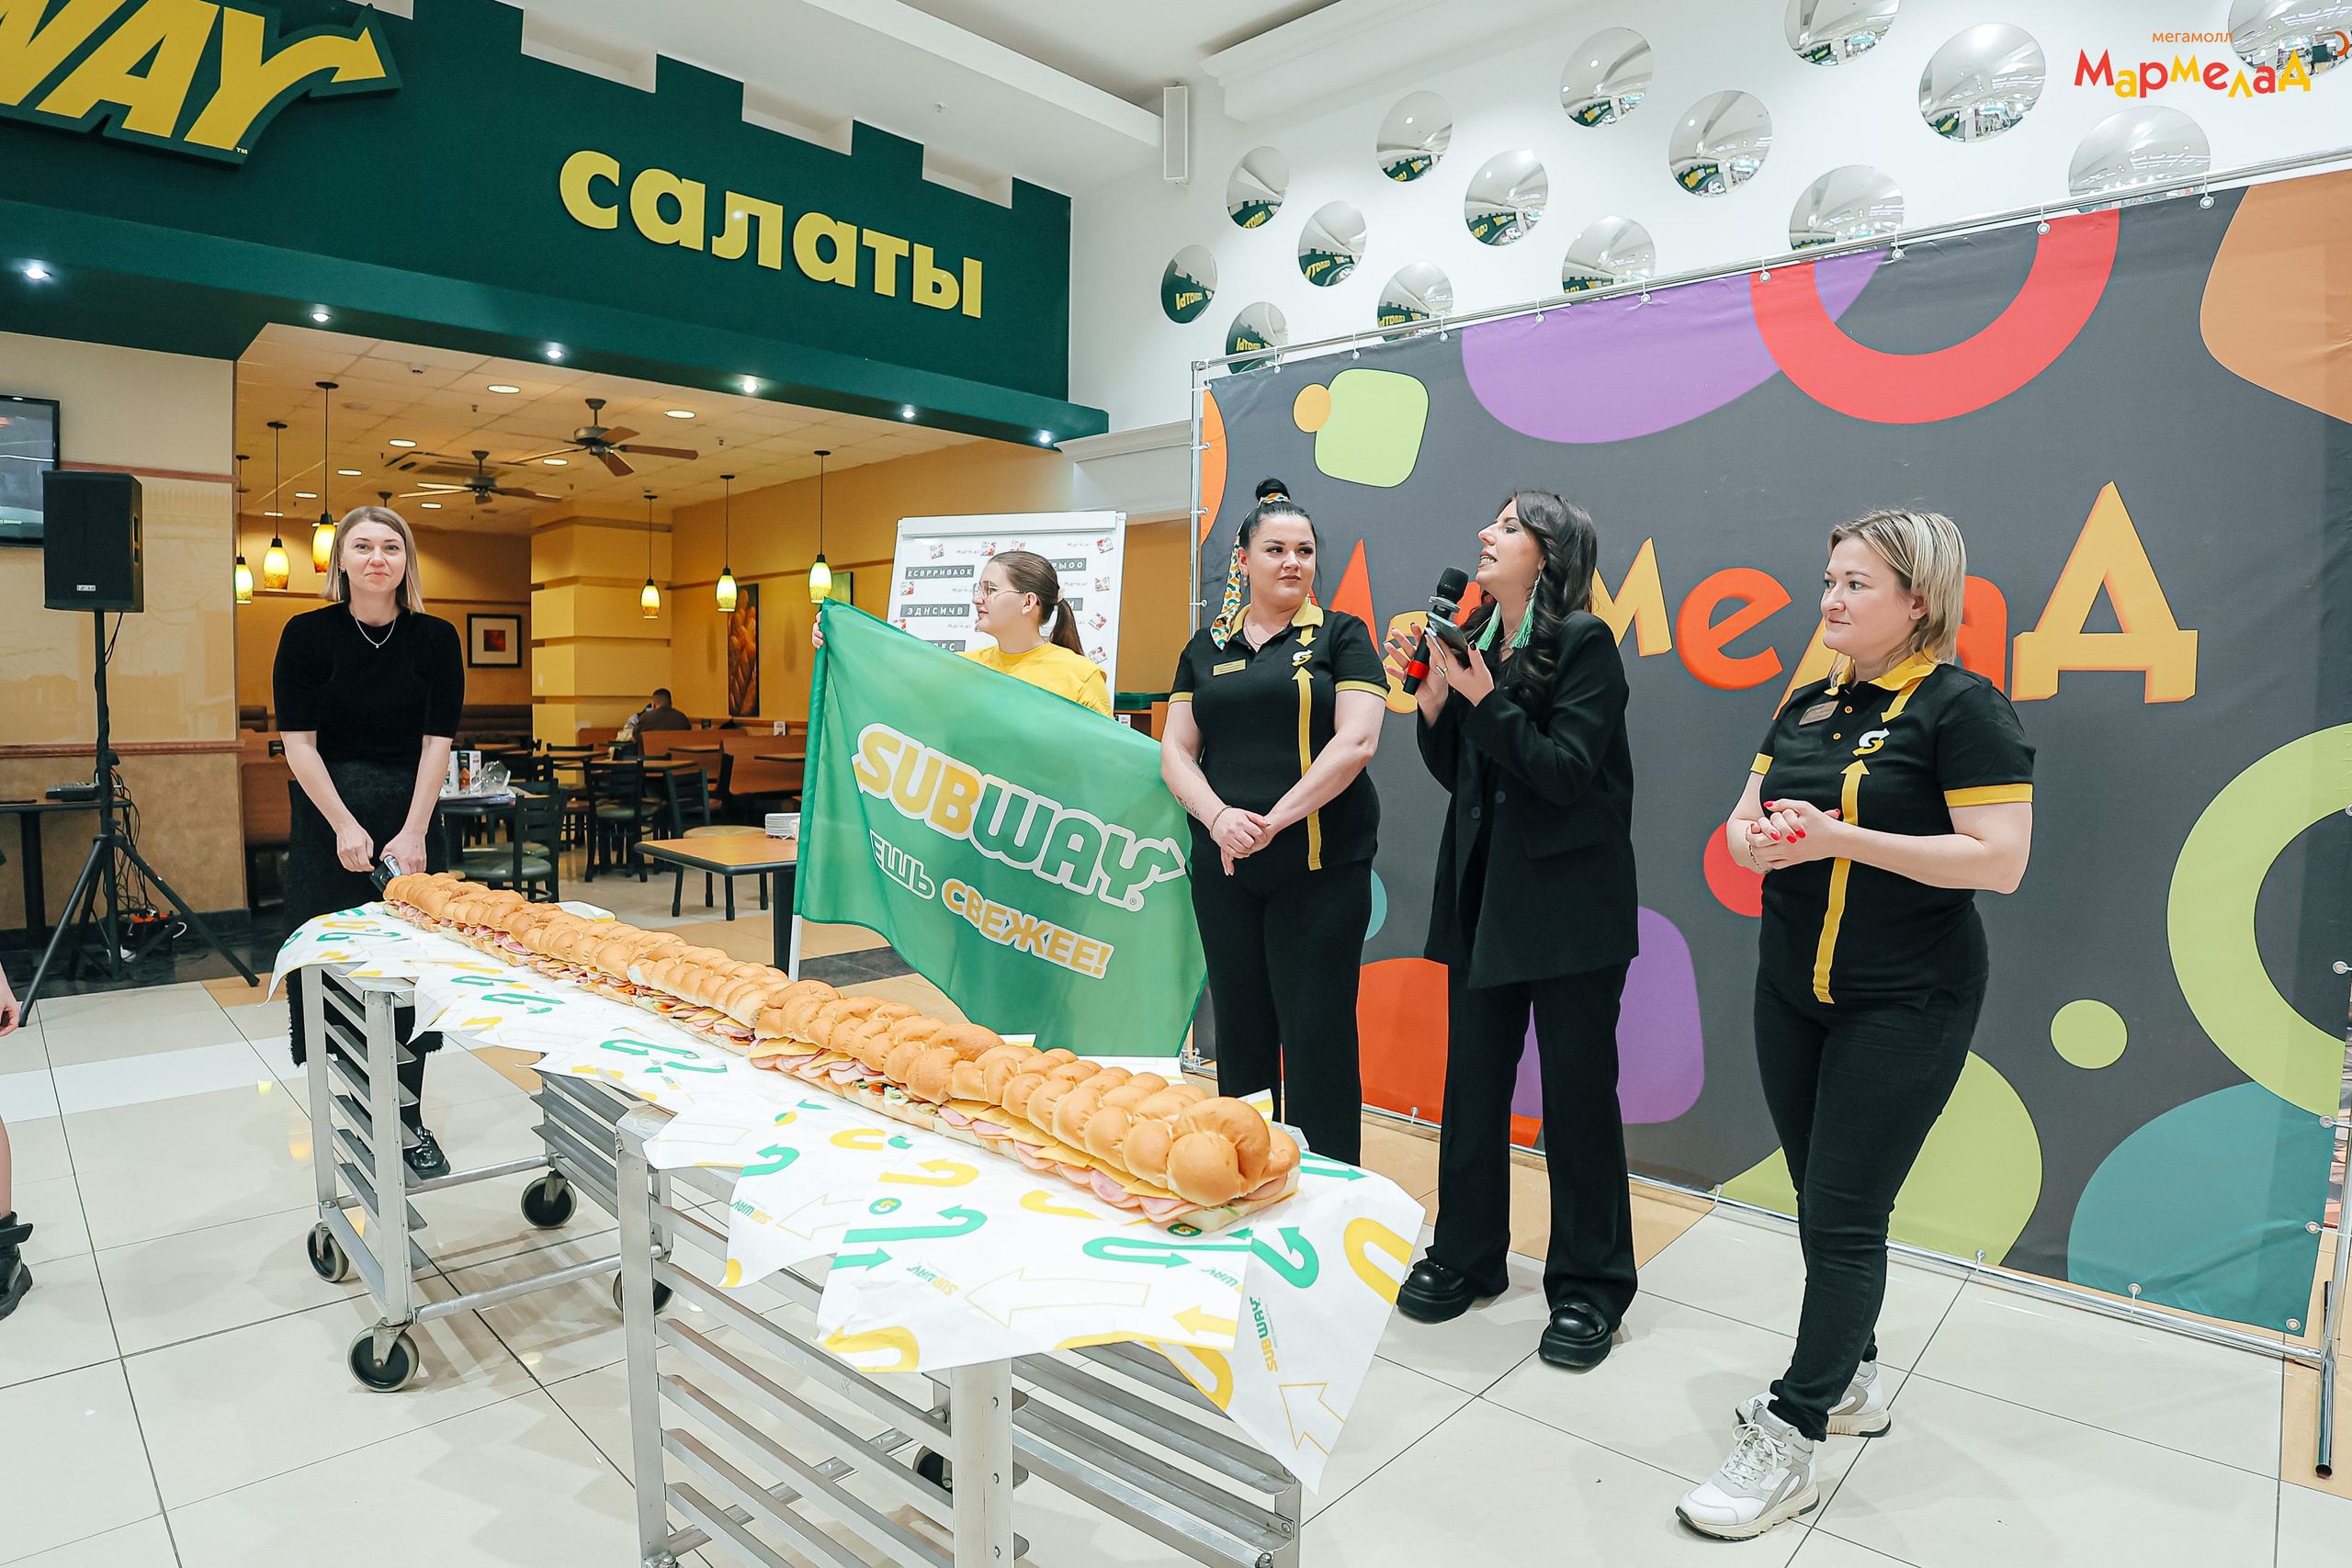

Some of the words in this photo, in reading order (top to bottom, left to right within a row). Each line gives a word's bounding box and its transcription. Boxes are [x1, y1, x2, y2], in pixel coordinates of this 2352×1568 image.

[560, 150, 982, 319] салаты
[906, 606, 964, 616] ЭДНСИЧВ
[908, 569, 973, 577] ЕСВРРИВАОК
[852, 724, 1186, 909] SUBWAY
[941, 877, 1115, 980] СВЕЖЕЕ!
[1249, 1296, 1279, 1372] SUBWAY
